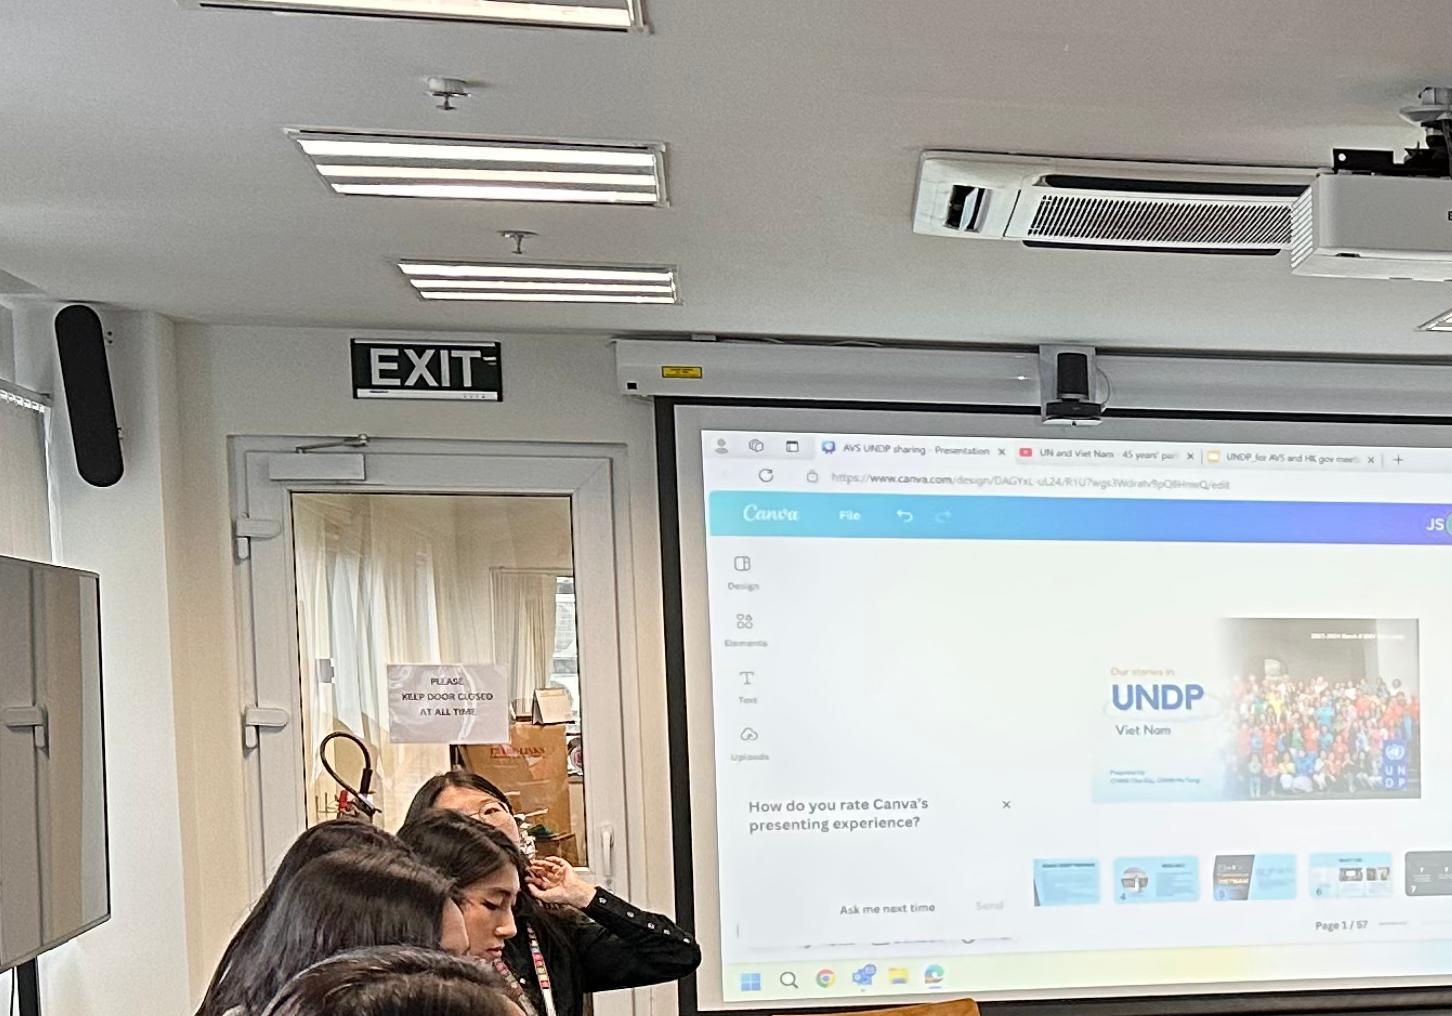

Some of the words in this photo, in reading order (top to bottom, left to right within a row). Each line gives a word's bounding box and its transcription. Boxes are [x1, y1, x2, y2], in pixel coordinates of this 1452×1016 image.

[369, 347, 481, 388] EXIT
[843, 444, 861, 453] AVS
[863, 445, 891, 454] UNDP
[893, 445, 926, 456] sharing
[934, 445, 990, 456] Presentation
[1056, 449, 1072, 458] and
[1094, 450, 1114, 459] Nam
[743, 503, 799, 522] Canva
[839, 510, 862, 521] File
[1426, 518, 1444, 531] JS
[727, 582, 760, 592] Design
[430, 676, 464, 686] PLEASE
[401, 692, 426, 701] KEEP
[427, 692, 456, 701] DOOR
[457, 692, 494, 701] CLOSED
[738, 696, 758, 705] Text
[1112, 683, 1205, 711] UNDP
[420, 707, 432, 717] AT
[434, 708, 451, 717] ALL
[453, 707, 476, 717] TIME
[1114, 724, 1140, 736] Viet
[1143, 724, 1172, 736] Nam
[748, 800, 782, 813] How
[786, 800, 805, 813] do
[808, 801, 836, 815] you
[840, 799, 869, 812] rate
[873, 798, 929, 811] Canva's
[749, 818, 830, 835] presenting
[832, 816, 920, 832] experience?
[839, 904, 860, 915] Ask
[862, 905, 881, 914] me
[883, 904, 908, 914] next
[910, 903, 936, 913] time
[1315, 920, 1340, 932] Page
[1341, 920, 1347, 930] 1
